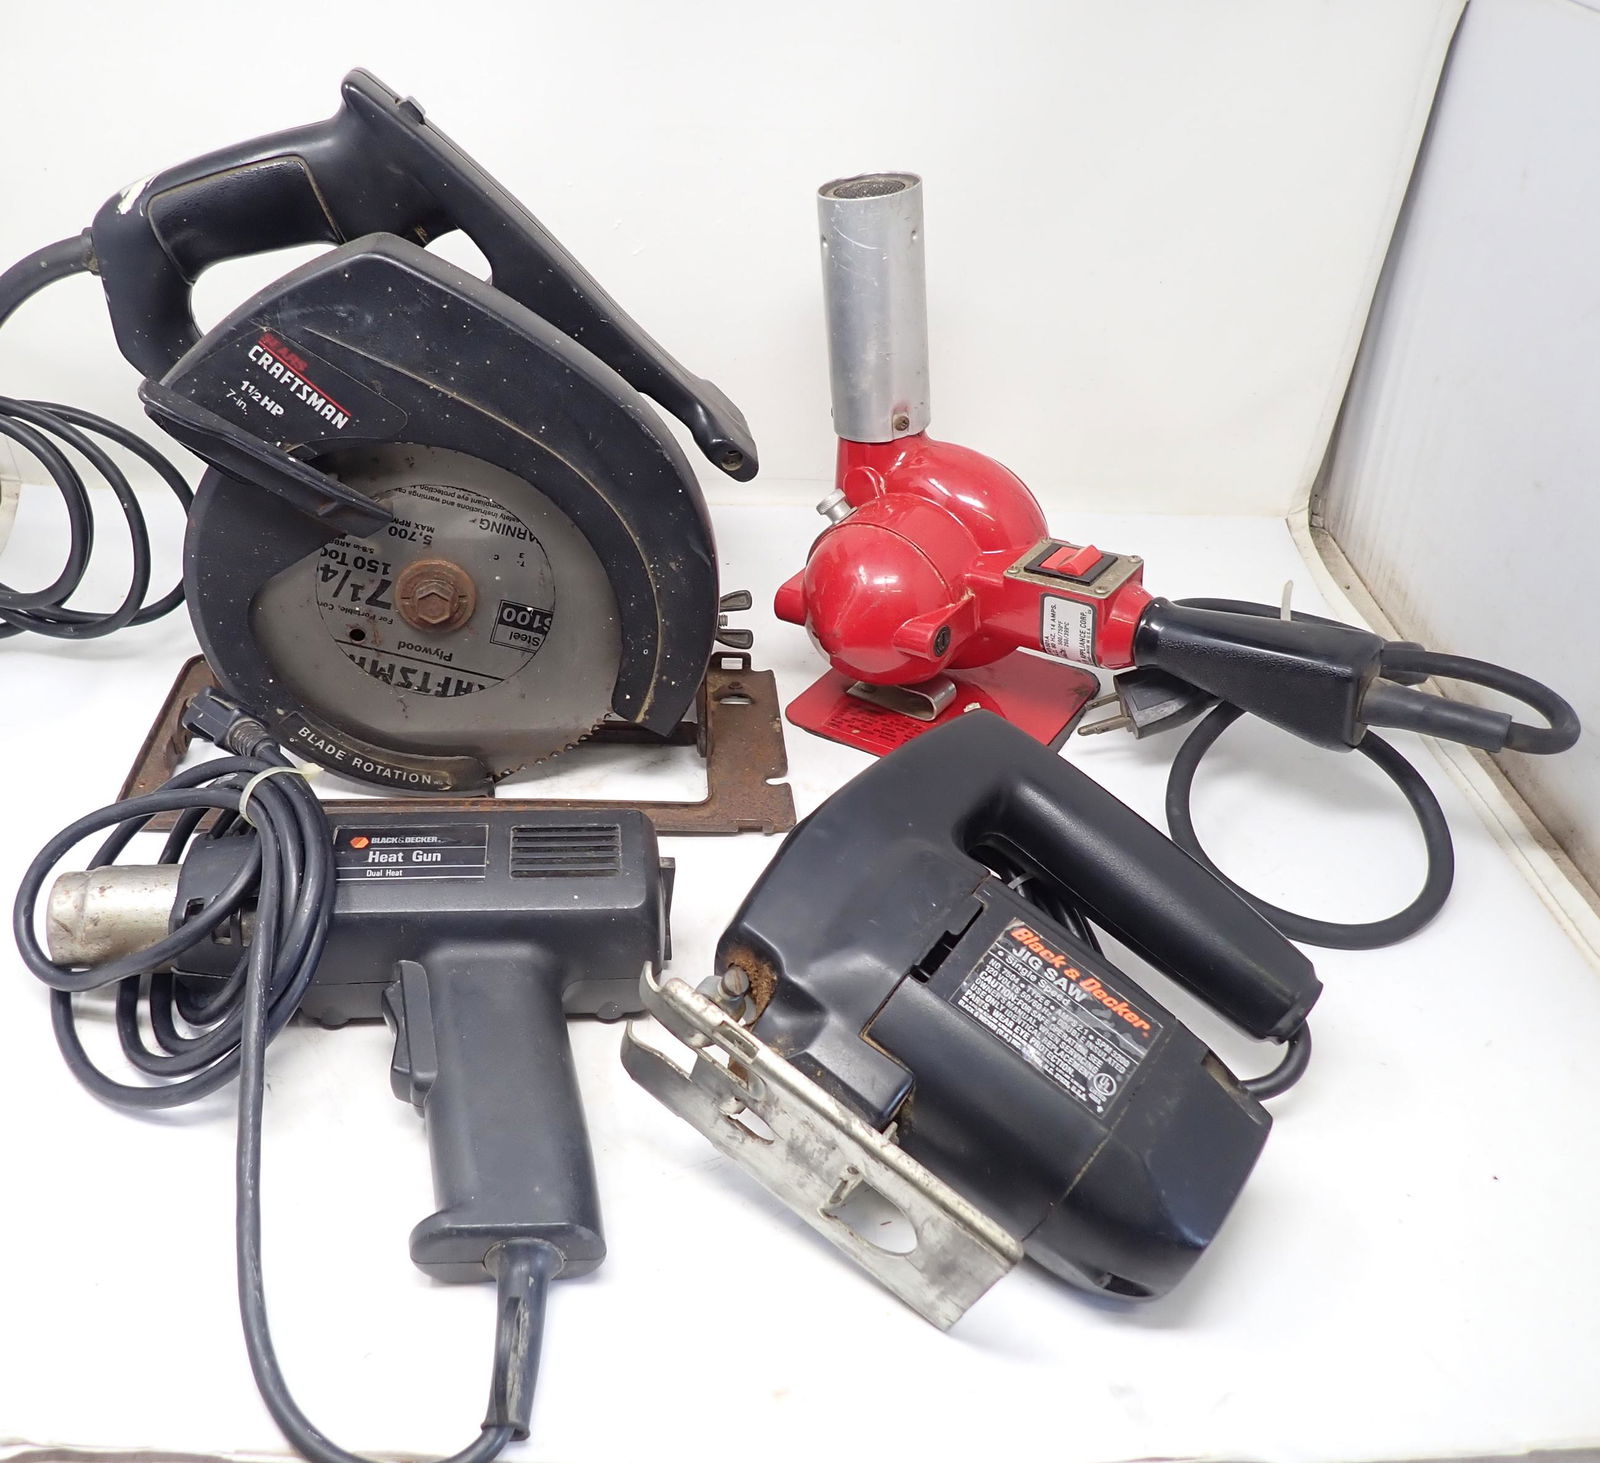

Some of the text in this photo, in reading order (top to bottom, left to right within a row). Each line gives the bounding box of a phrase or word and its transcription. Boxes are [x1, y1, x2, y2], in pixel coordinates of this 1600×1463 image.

[248, 345, 348, 429] CRAFTSMAN
[409, 490, 440, 502] warnings
[457, 502, 498, 518] instructions
[389, 526, 433, 545] 5,700
[415, 521, 434, 533] MAX
[479, 518, 541, 544] ARNING
[353, 556, 392, 575] 150
[379, 616, 393, 624] For
[398, 641, 453, 661] Plywood
[509, 632, 540, 646] Steel
[350, 654, 486, 697] AFTSM
[298, 727, 431, 785] BLADE ROTATION
[368, 850, 441, 862] Heat Gun
[366, 869, 402, 877] Dual Heat
[1010, 928, 1068, 969] Black
[1063, 967, 1081, 982] &
[1000, 967, 1020, 984] 7504
[1005, 955, 1071, 1006] Single Speed
[1012, 946, 1087, 1002] JIG SAW
[969, 982, 987, 998] USE
[983, 993, 1005, 1013] ONLY
[1003, 1008, 1042, 1040] IDENTICAL
[1040, 1036, 1094, 1080] REPLACEMENT
[983, 964, 999, 977] 120
[995, 973, 1021, 994] VOLTS
[1019, 990, 1043, 1011] 50/60
[1055, 1018, 1086, 1044] DOUBLE
[1083, 1039, 1126, 1074] INSULATED
[964, 989, 992, 1012] PARTS.
[991, 1008, 1015, 1029] WEAR
[1012, 1025, 1030, 1041] EYE
[1028, 1037, 1077, 1077] PROTECTION.
[1016, 998, 1032, 1013] FOR
[1029, 1008, 1050, 1027] SAFE
[1087, 1052, 1104, 1067] SEE
[1036, 1023, 1061, 1045] WHEN
[1058, 1041, 1099, 1074] SERVICING
